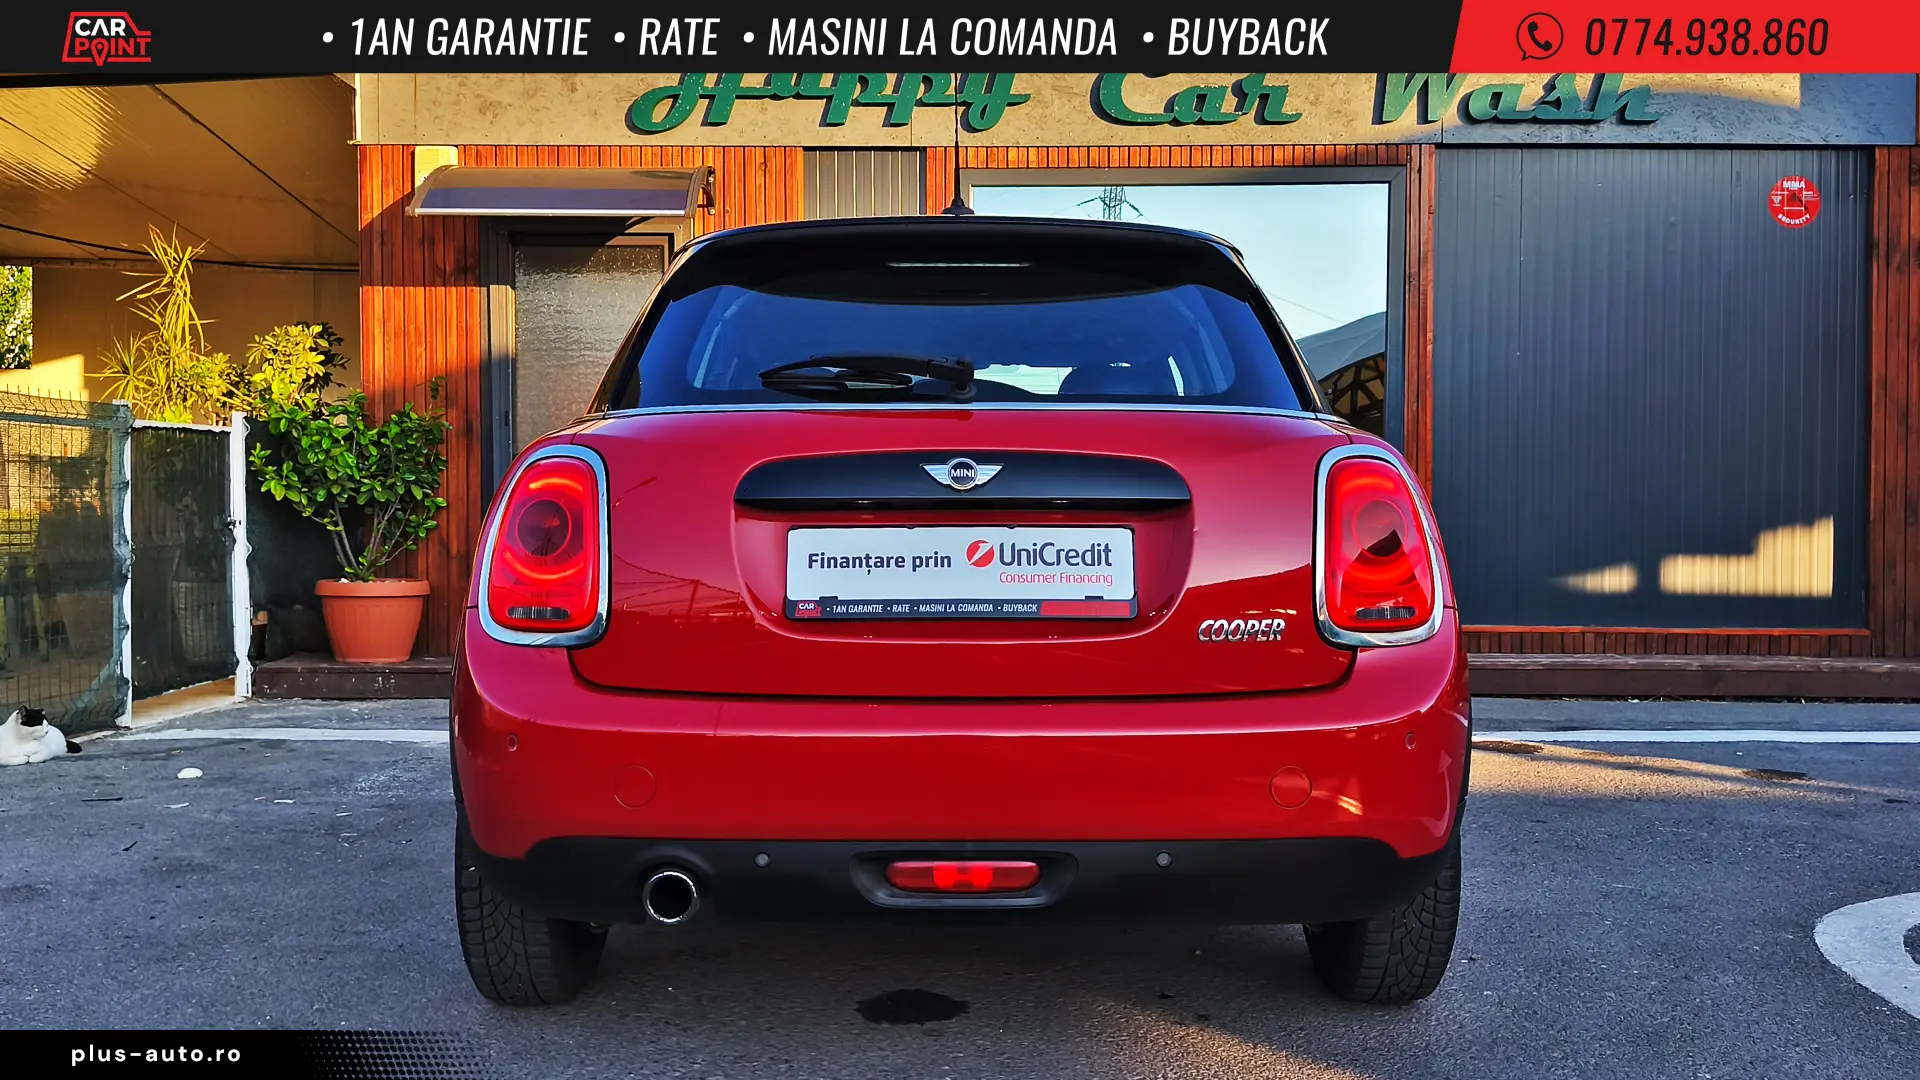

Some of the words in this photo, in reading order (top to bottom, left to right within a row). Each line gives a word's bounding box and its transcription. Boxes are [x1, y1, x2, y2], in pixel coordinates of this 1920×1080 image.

[1096, 73, 1303, 124] Car
[1380, 73, 1662, 124] Wash
[1782, 180, 1806, 189] MMA
[1777, 213, 1811, 225] SECURITY
[950, 468, 975, 478] MINI
[999, 541, 1113, 567] UniCredit
[807, 551, 906, 575] Finanțare
[911, 551, 952, 572] prin
[999, 571, 1057, 584] Consumer
[1059, 571, 1113, 587] Financing
[832, 604, 847, 613] 1AN
[848, 604, 884, 613] GARANTIE
[892, 604, 910, 613] RATE
[919, 604, 945, 613] MASINI
[946, 604, 956, 612] LA
[957, 603, 994, 612] COMANDA
[1002, 603, 1038, 612] BUYBACK
[1198, 619, 1286, 642] COOPER
